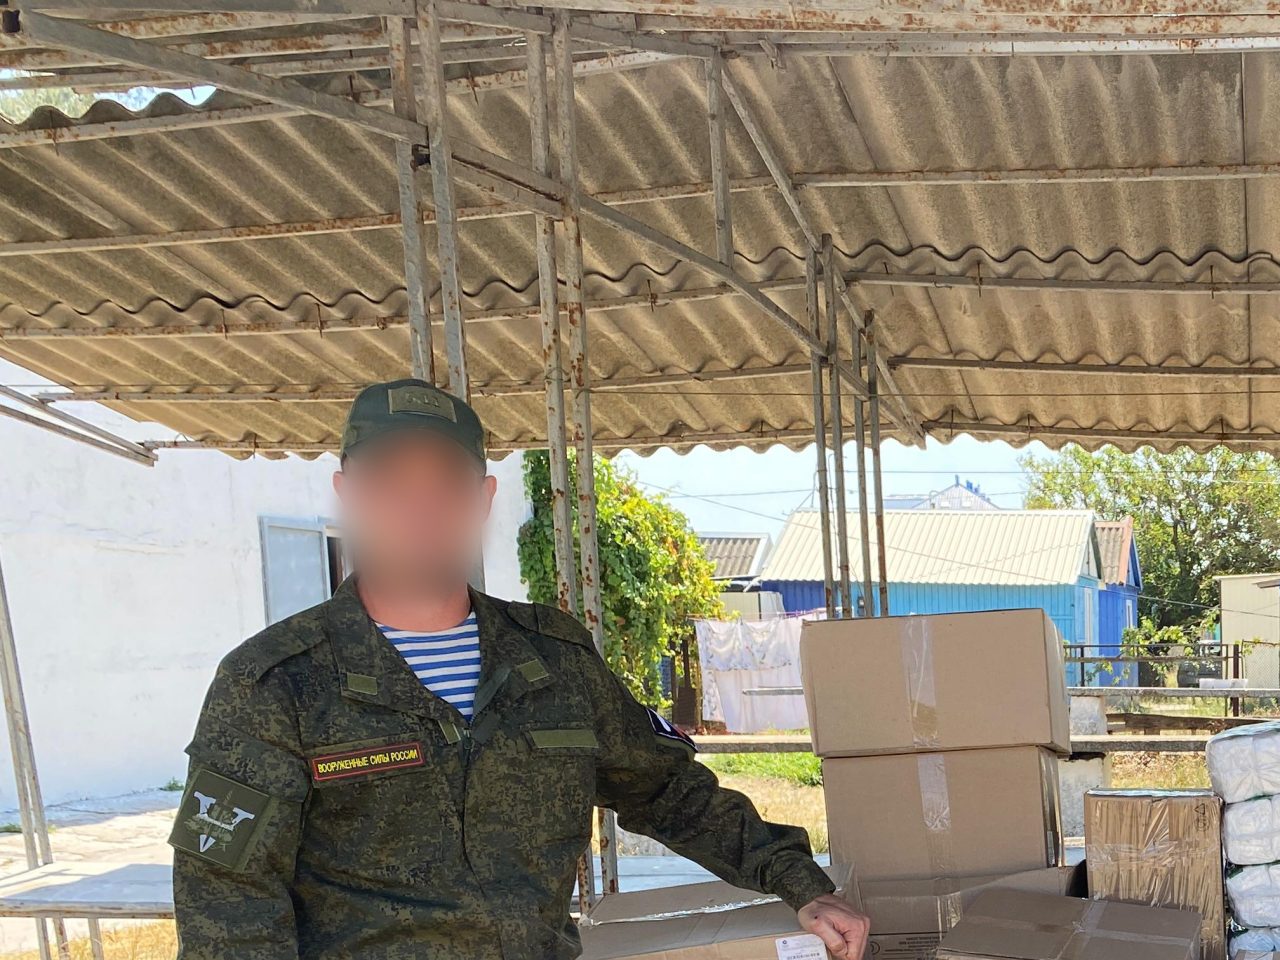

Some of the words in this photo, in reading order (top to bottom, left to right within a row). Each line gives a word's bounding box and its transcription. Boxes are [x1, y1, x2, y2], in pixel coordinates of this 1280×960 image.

[317, 756, 369, 773] ВООРУЖЕННЫЕ
[370, 753, 390, 765] СИЛЫ
[391, 749, 418, 762] РОССИИ
